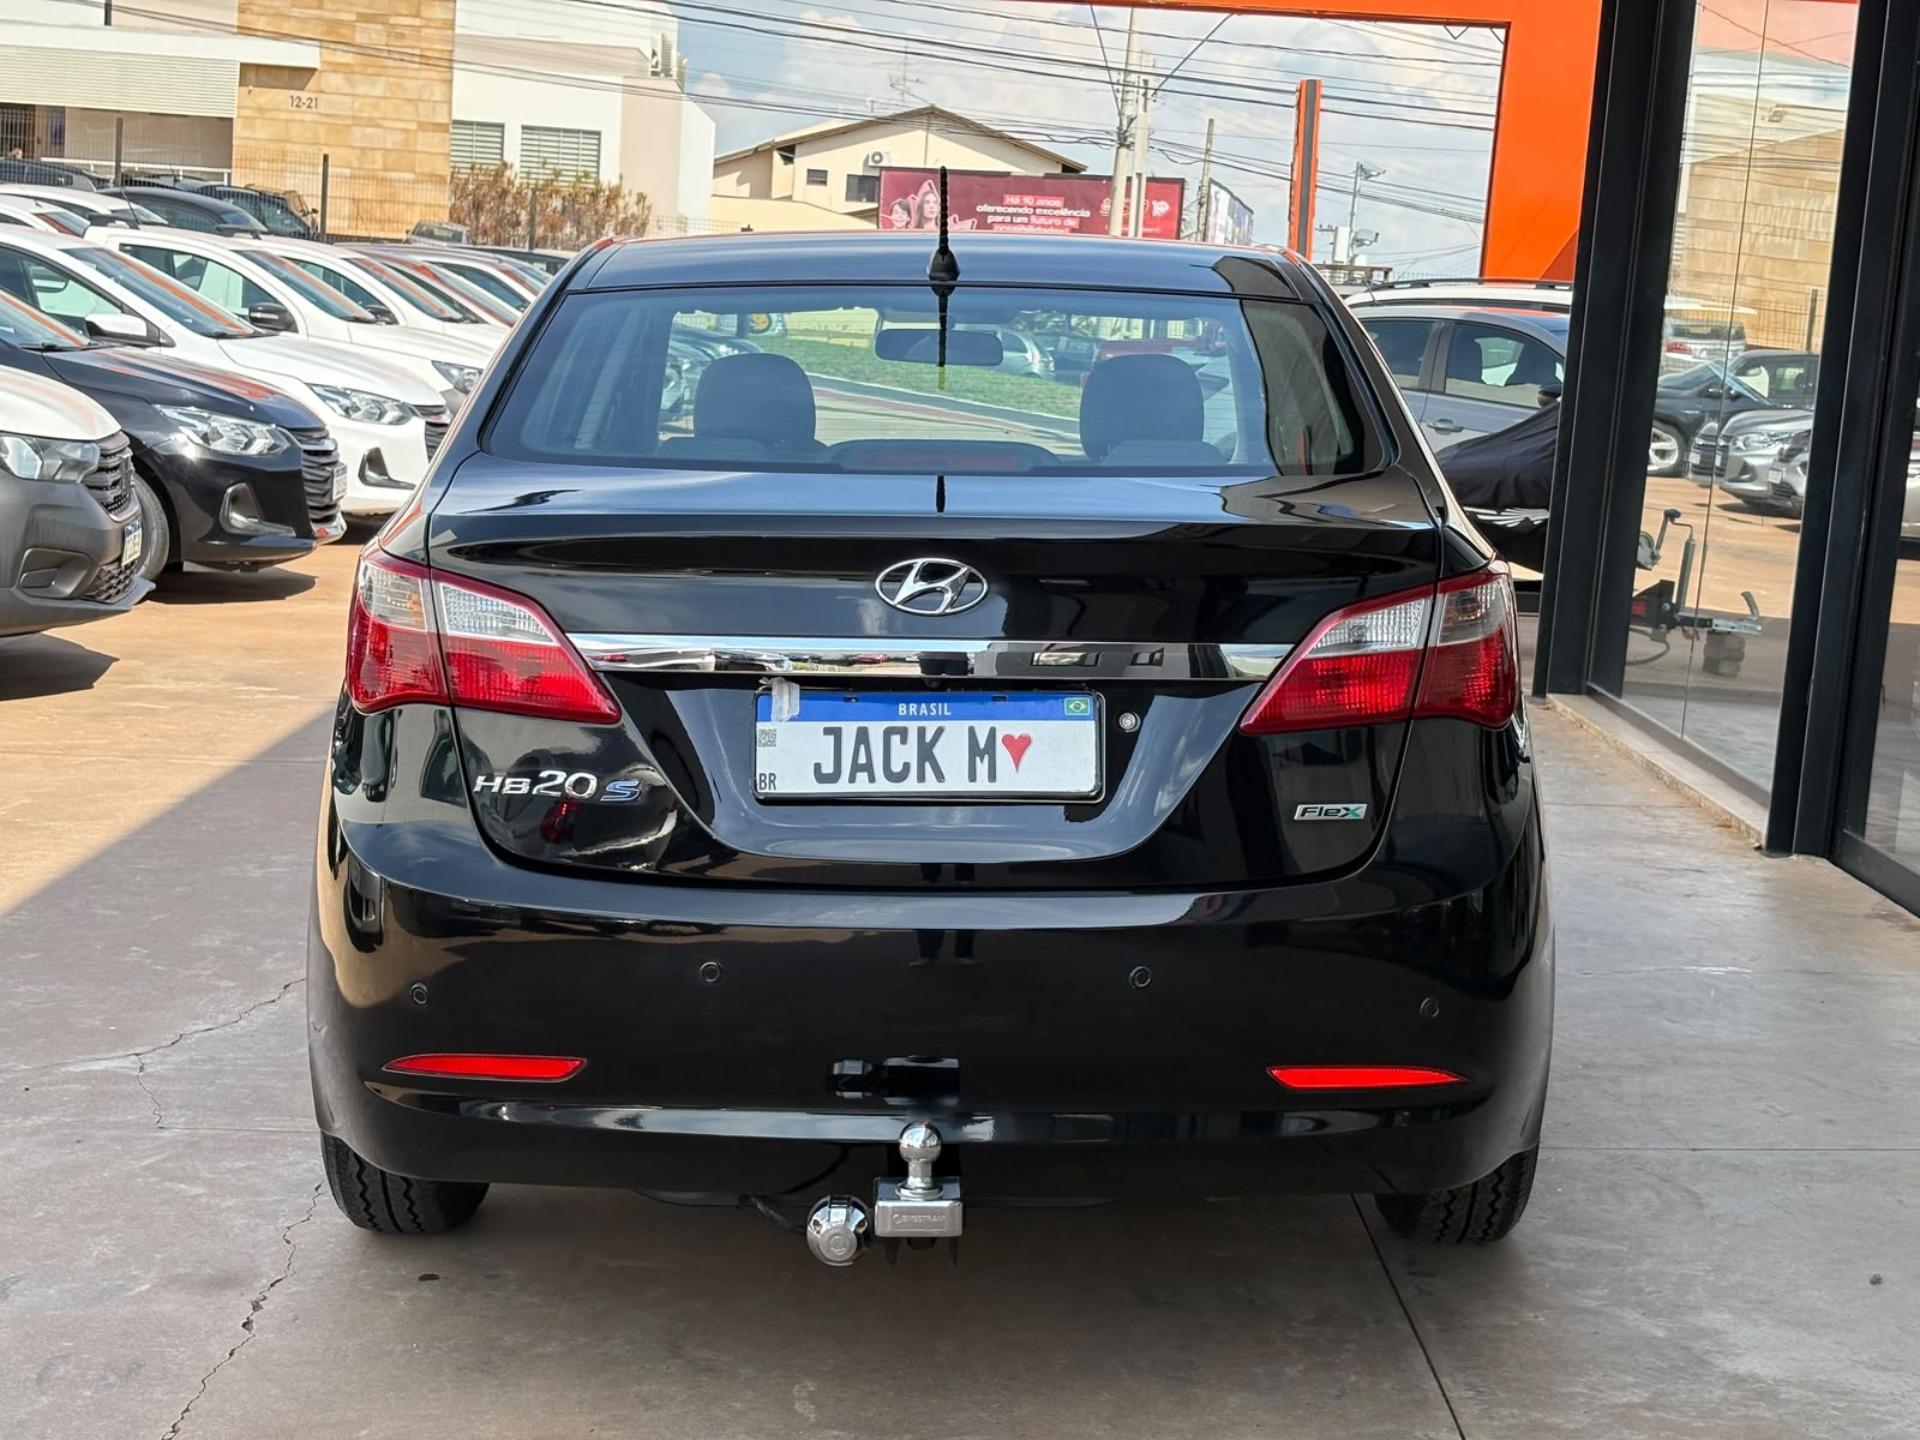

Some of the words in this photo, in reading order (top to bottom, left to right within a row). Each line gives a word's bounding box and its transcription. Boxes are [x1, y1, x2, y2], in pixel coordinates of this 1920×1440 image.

[289, 95, 318, 110] 12-21
[976, 203, 1034, 215] oferecendo
[1035, 207, 1091, 218] excelência
[987, 214, 1011, 225] para
[898, 703, 951, 716] BRASIL
[813, 726, 946, 785] JACK
[759, 772, 776, 791] BR
[1300, 806, 1364, 818] Flex
